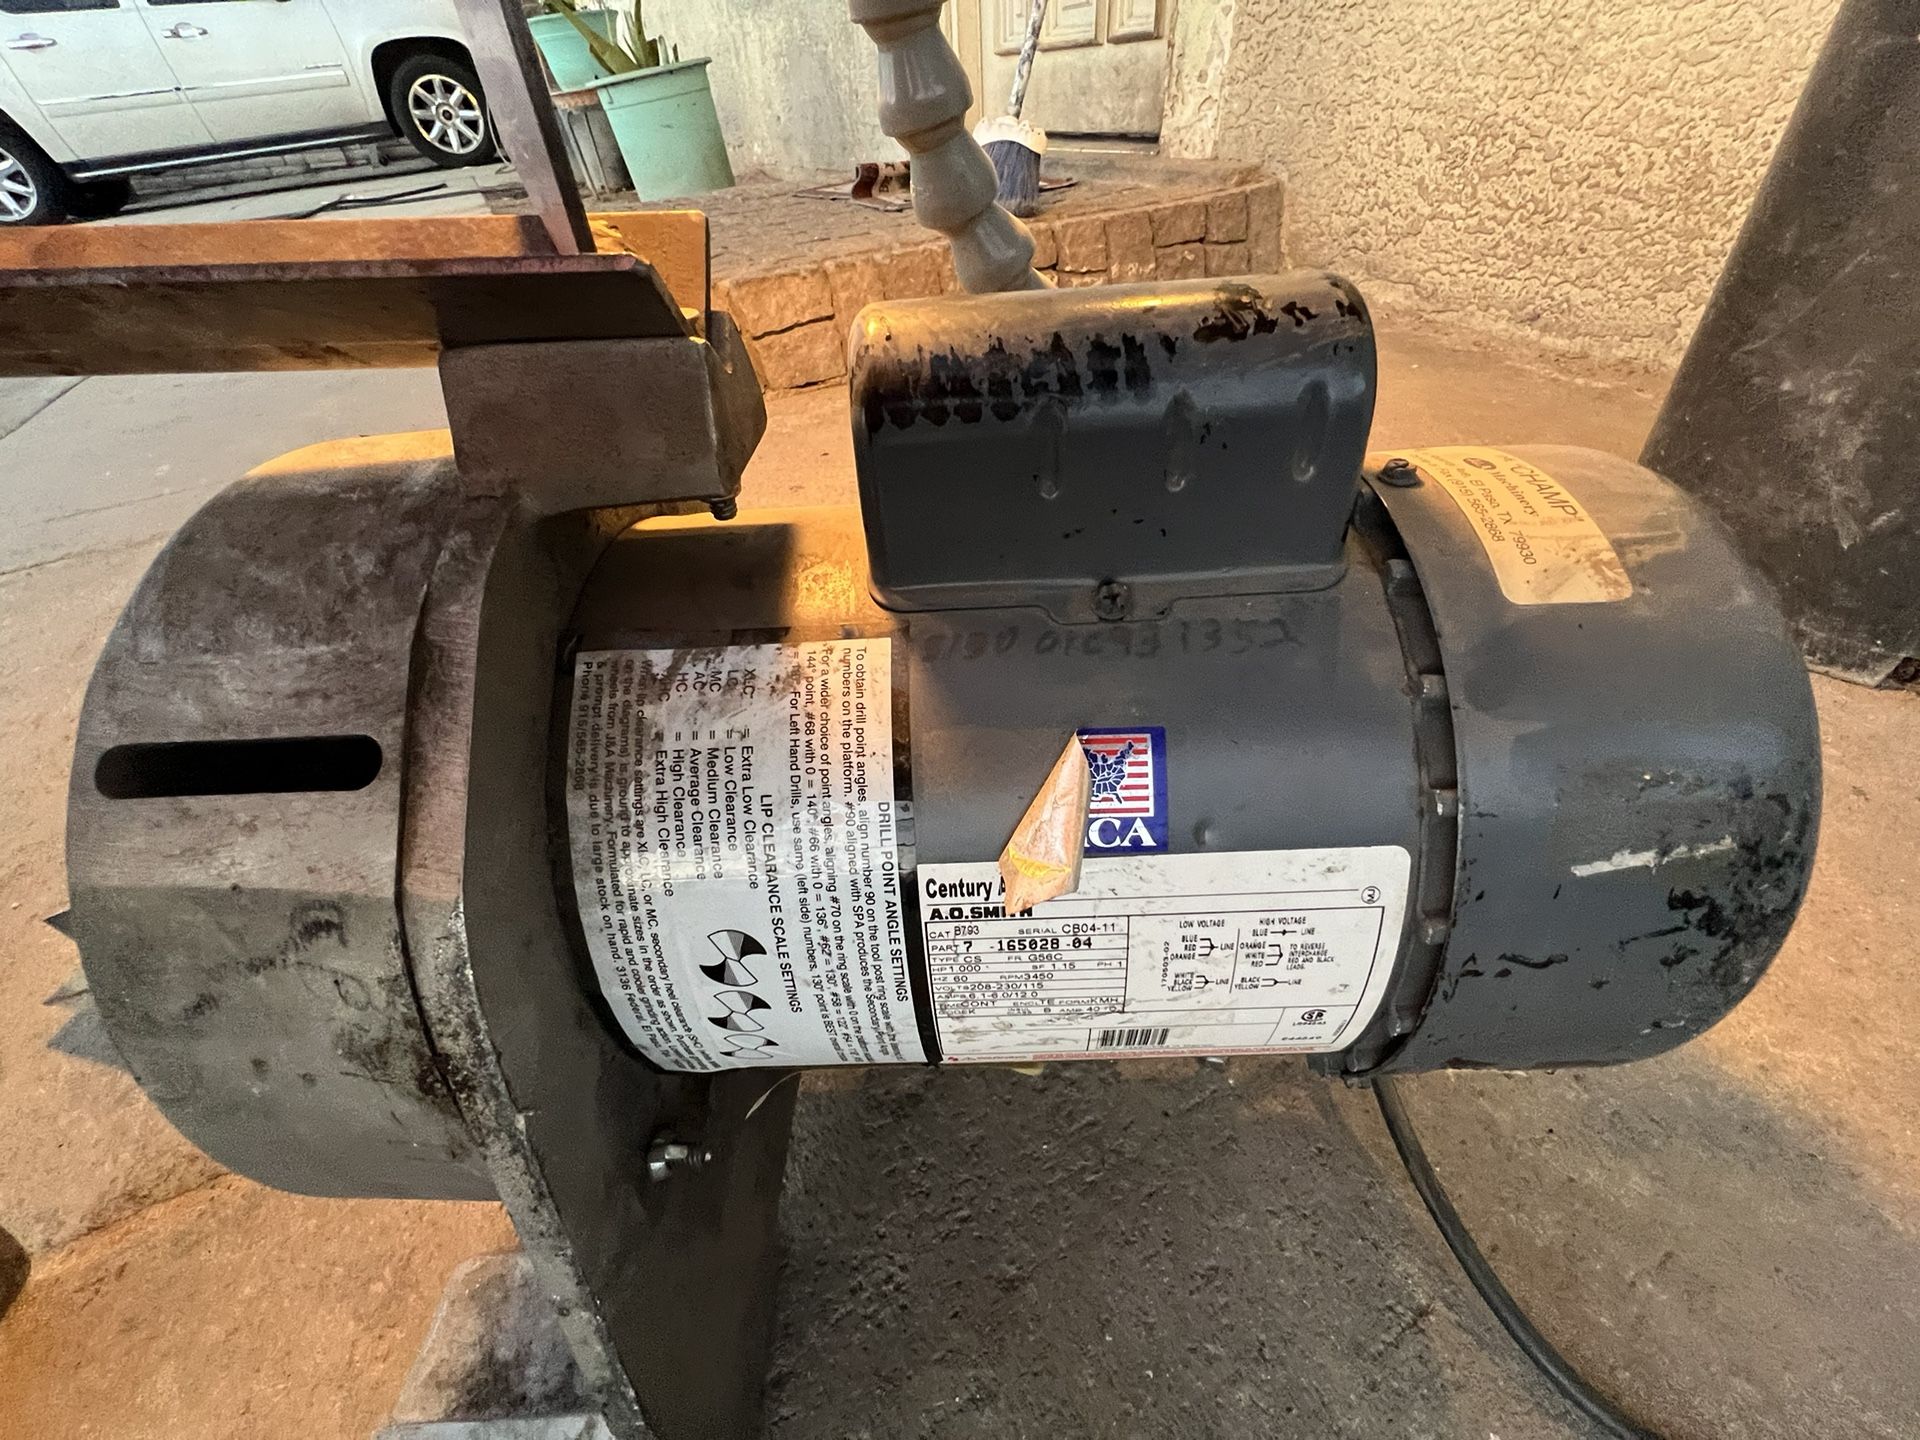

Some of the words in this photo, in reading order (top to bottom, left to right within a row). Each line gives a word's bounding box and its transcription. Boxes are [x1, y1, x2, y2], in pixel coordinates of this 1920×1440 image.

[1509, 530, 1537, 565] 79930
[822, 649, 830, 666] For
[856, 647, 867, 660] To
[676, 672, 687, 692] HC
[693, 672, 705, 691] AC
[710, 671, 722, 692] MC
[842, 648, 852, 697] numbers
[856, 664, 866, 698] obtain
[791, 691, 800, 710] For
[804, 676, 815, 707] point,
[821, 679, 831, 709] wider
[842, 701, 852, 715] on
[856, 702, 867, 723] drill
[790, 714, 800, 735] Left
[805, 712, 815, 735] #68
[820, 712, 831, 750] choice
[842, 720, 853, 738] the
[790, 739, 800, 770] Hand
[806, 739, 815, 763] with
[853, 728, 867, 758] point
[655, 750, 668, 785] Extra
[671, 749, 685, 781] High
[725, 747, 736, 775] Low
[742, 746, 753, 781] Extra
[806, 767, 815, 775] 0
[821, 754, 831, 765] of
[841, 743, 853, 796] platform.
[688, 748, 701, 806] Average
[707, 748, 719, 804] Medium
[819, 769, 832, 798] point
[742, 787, 753, 815] Low
[790, 775, 801, 808] Drills,
[654, 791, 668, 823] High
[725, 780, 737, 851] Clearance
[761, 795, 772, 817] LIP
[845, 802, 856, 826] #90
[621, 826, 631, 836] to
[633, 820, 645, 838] are
[673, 787, 686, 857] Clearance
[792, 813, 801, 834] use
[857, 810, 870, 839] align
[879, 802, 892, 847] DRILL
[1083, 816, 1157, 848] CA
[692, 811, 706, 880] Clearance
[709, 809, 724, 879] Clearance
[809, 828, 819, 852] #66
[658, 828, 673, 897] Clearance
[744, 820, 759, 889] Clearance
[845, 831, 859, 875] aligned
[763, 823, 781, 913] CLEARANCE
[811, 855, 821, 879] with
[825, 848, 838, 892] aligning
[860, 843, 873, 888] number
[881, 851, 895, 896] POINT
[596, 878, 609, 910] stock
[795, 874, 808, 894] (left
[850, 879, 861, 901] with
[926, 878, 993, 901] Century
[616, 901, 625, 914] for
[643, 895, 652, 905] or
[830, 896, 841, 917] #70
[865, 892, 875, 905] 90
[603, 915, 612, 929] on
[646, 909, 659, 930] MC,
[799, 898, 812, 923] side)
[853, 905, 864, 928] SPA
[867, 909, 875, 922] on
[930, 905, 1033, 920] A.O.SMIH
[618, 919, 633, 944] rapid
[632, 916, 645, 942] sizes
[833, 920, 842, 933] on
[870, 925, 879, 941] the
[885, 900, 900, 945] ANGLE
[929, 931, 950, 939] CAT
[1018, 927, 1057, 935] SERIAL
[1061, 922, 1115, 934] CB04-11
[1179, 920, 1194, 928] LOW
[1197, 919, 1225, 928] VOLTAGE
[1252, 928, 1268, 937] BLUE
[607, 933, 621, 962] hand.
[639, 945, 648, 954] in
[772, 917, 789, 959] SCALE
[803, 927, 817, 971] numbers,
[835, 936, 846, 950] the
[625, 948, 636, 965] and
[642, 958, 654, 970] the
[650, 933, 670, 981] secondary
[836, 953, 848, 970] ring
[852, 932, 870, 976] produces
[871, 944, 884, 961] tool
[616, 967, 631, 990] 3136
[631, 969, 645, 994] cooler
[648, 975, 661, 996] order
[840, 973, 853, 994] scale
[863, 979, 874, 992] the
[872, 965, 886, 984] post
[891, 949, 908, 1001] SETTINGS
[664, 983, 678, 1000] heel
[780, 963, 802, 1013] SETTINGS
[831, 992, 842, 1007] #58
[877, 986, 886, 1000] ring
[640, 997, 659, 1026] grinding
[657, 1000, 666, 1008] as
[814, 994, 829, 1012] point
[845, 995, 858, 1010] with
[879, 1002, 891, 1019] scale
